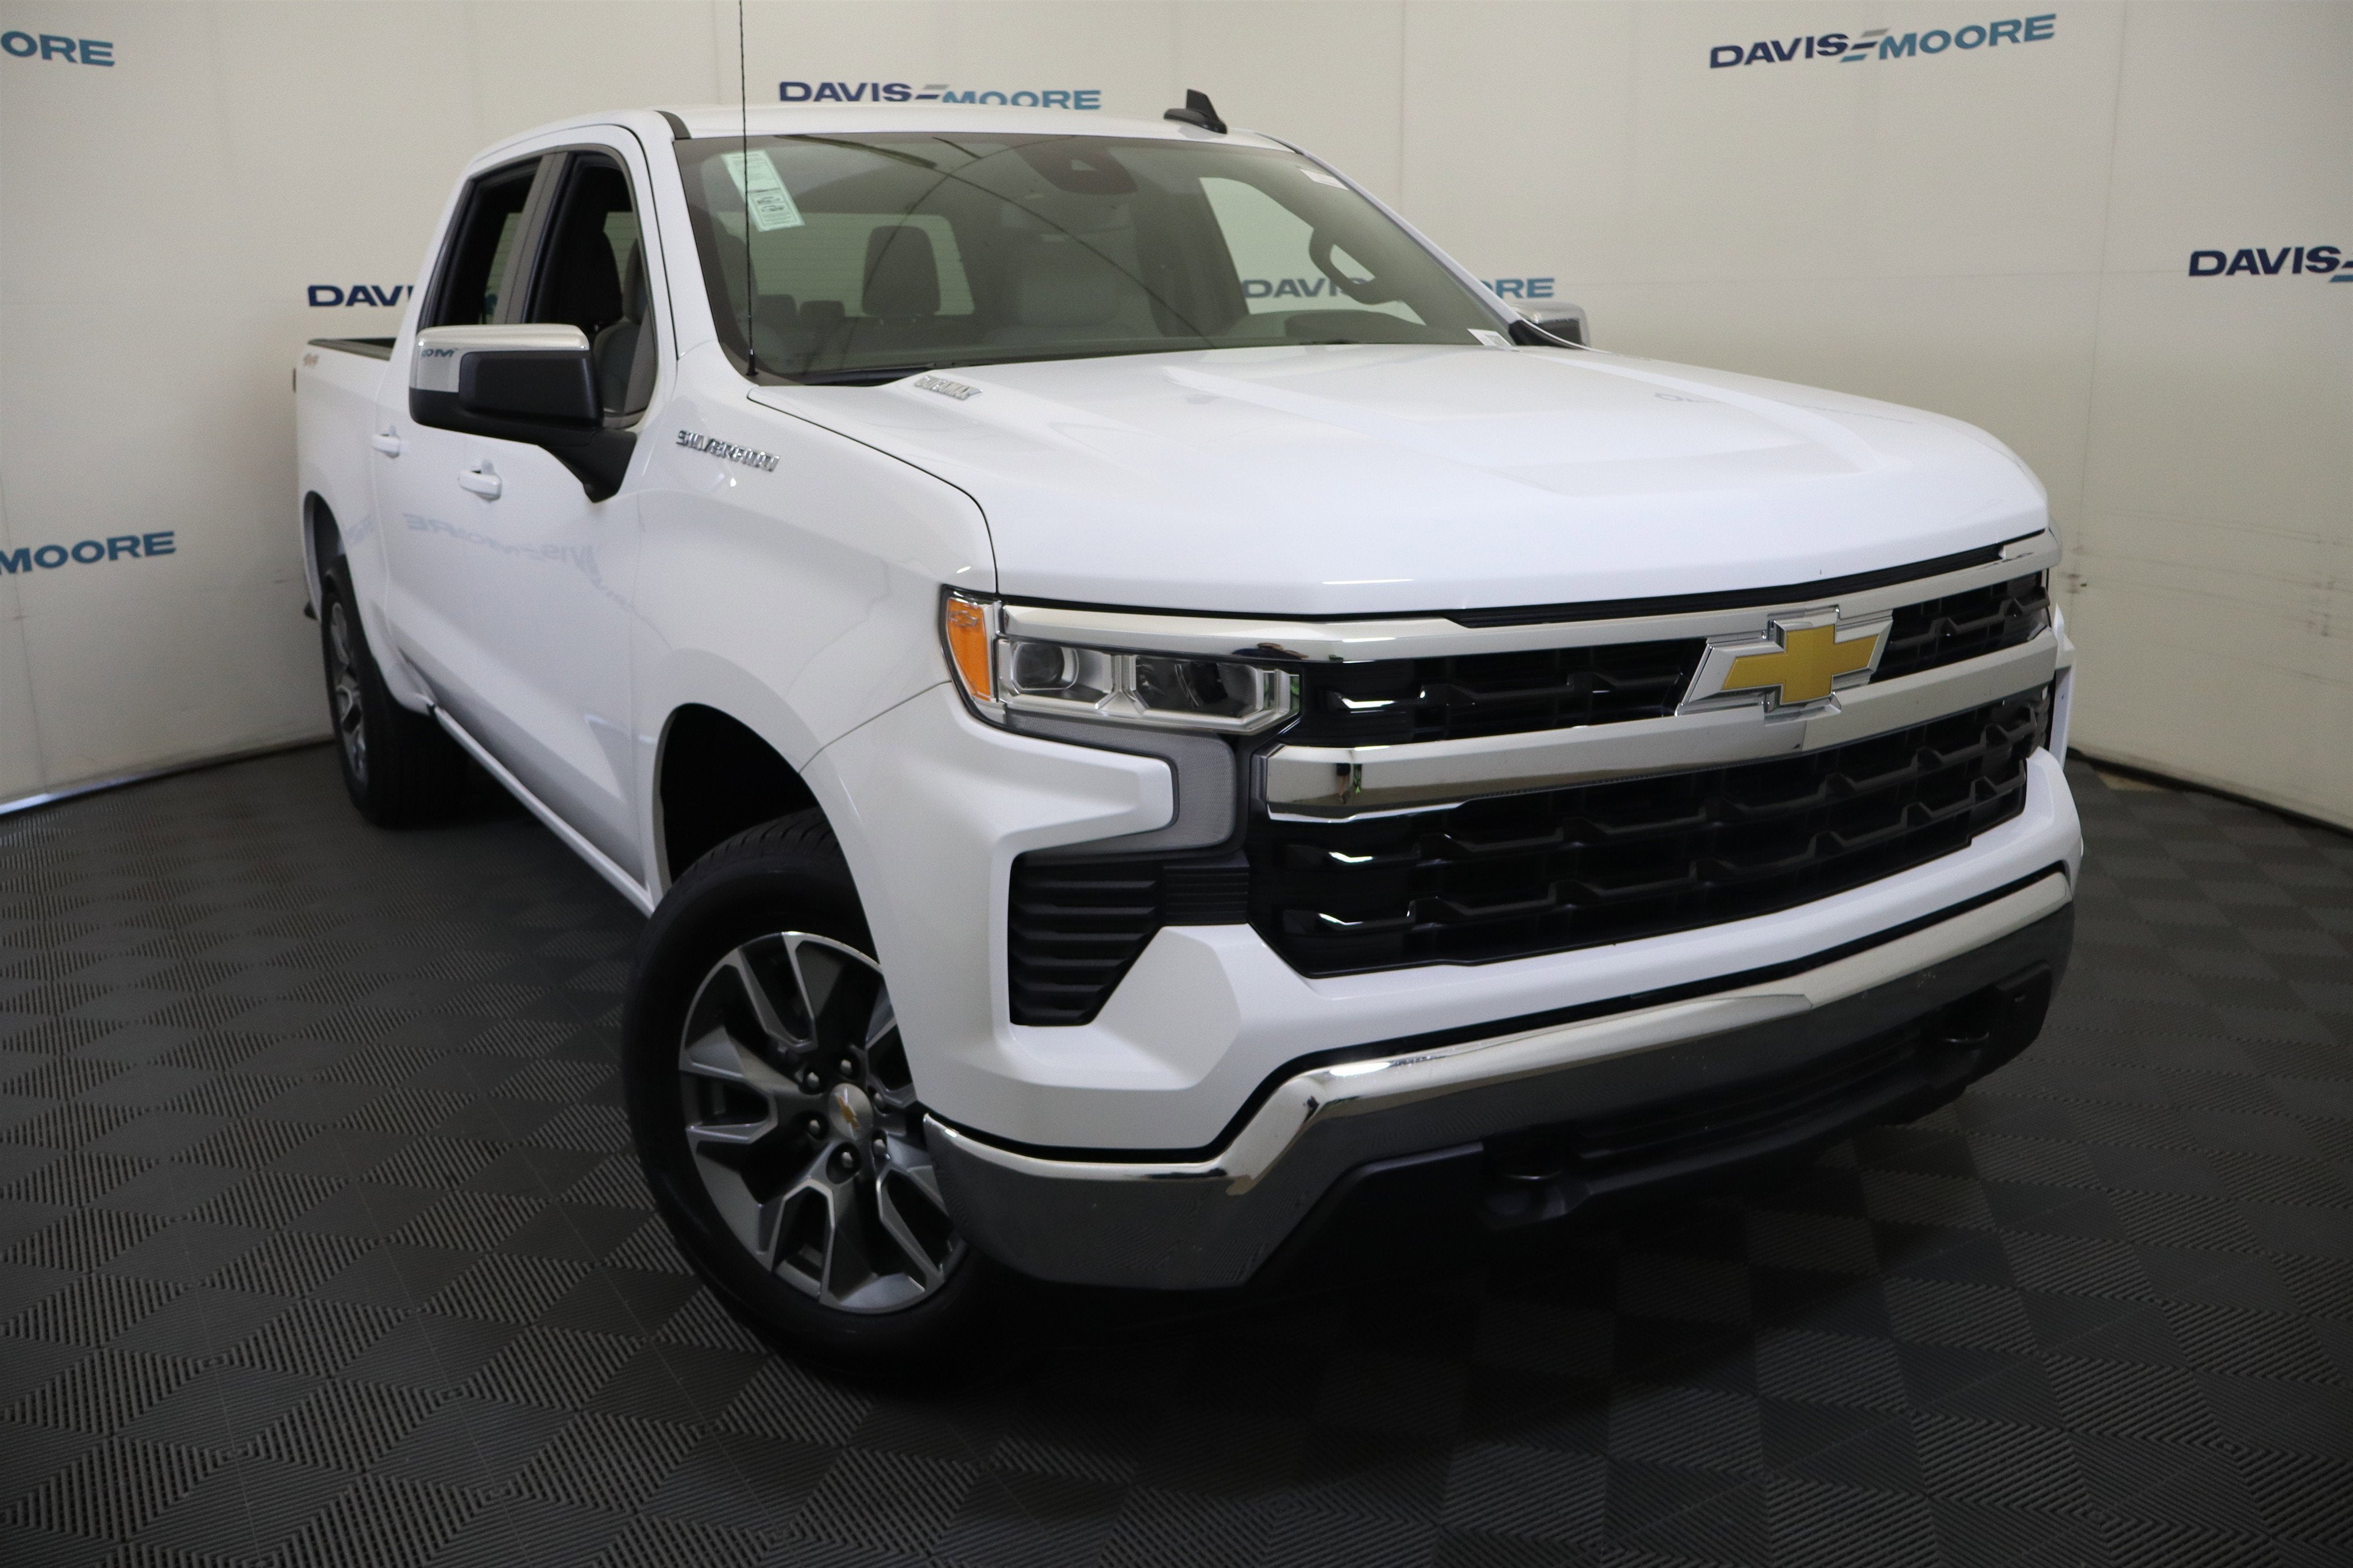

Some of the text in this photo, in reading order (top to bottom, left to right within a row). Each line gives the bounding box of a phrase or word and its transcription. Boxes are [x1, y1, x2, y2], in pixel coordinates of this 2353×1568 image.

[1, 30, 115, 67] ORE
[1710, 13, 2057, 68] DAVIS MOORE
[779, 82, 1101, 110] DAVIS MOORE
[2189, 246, 2340, 277] DAVIS
[1481, 278, 1554, 299] RE
[0, 531, 176, 574] MOORE
